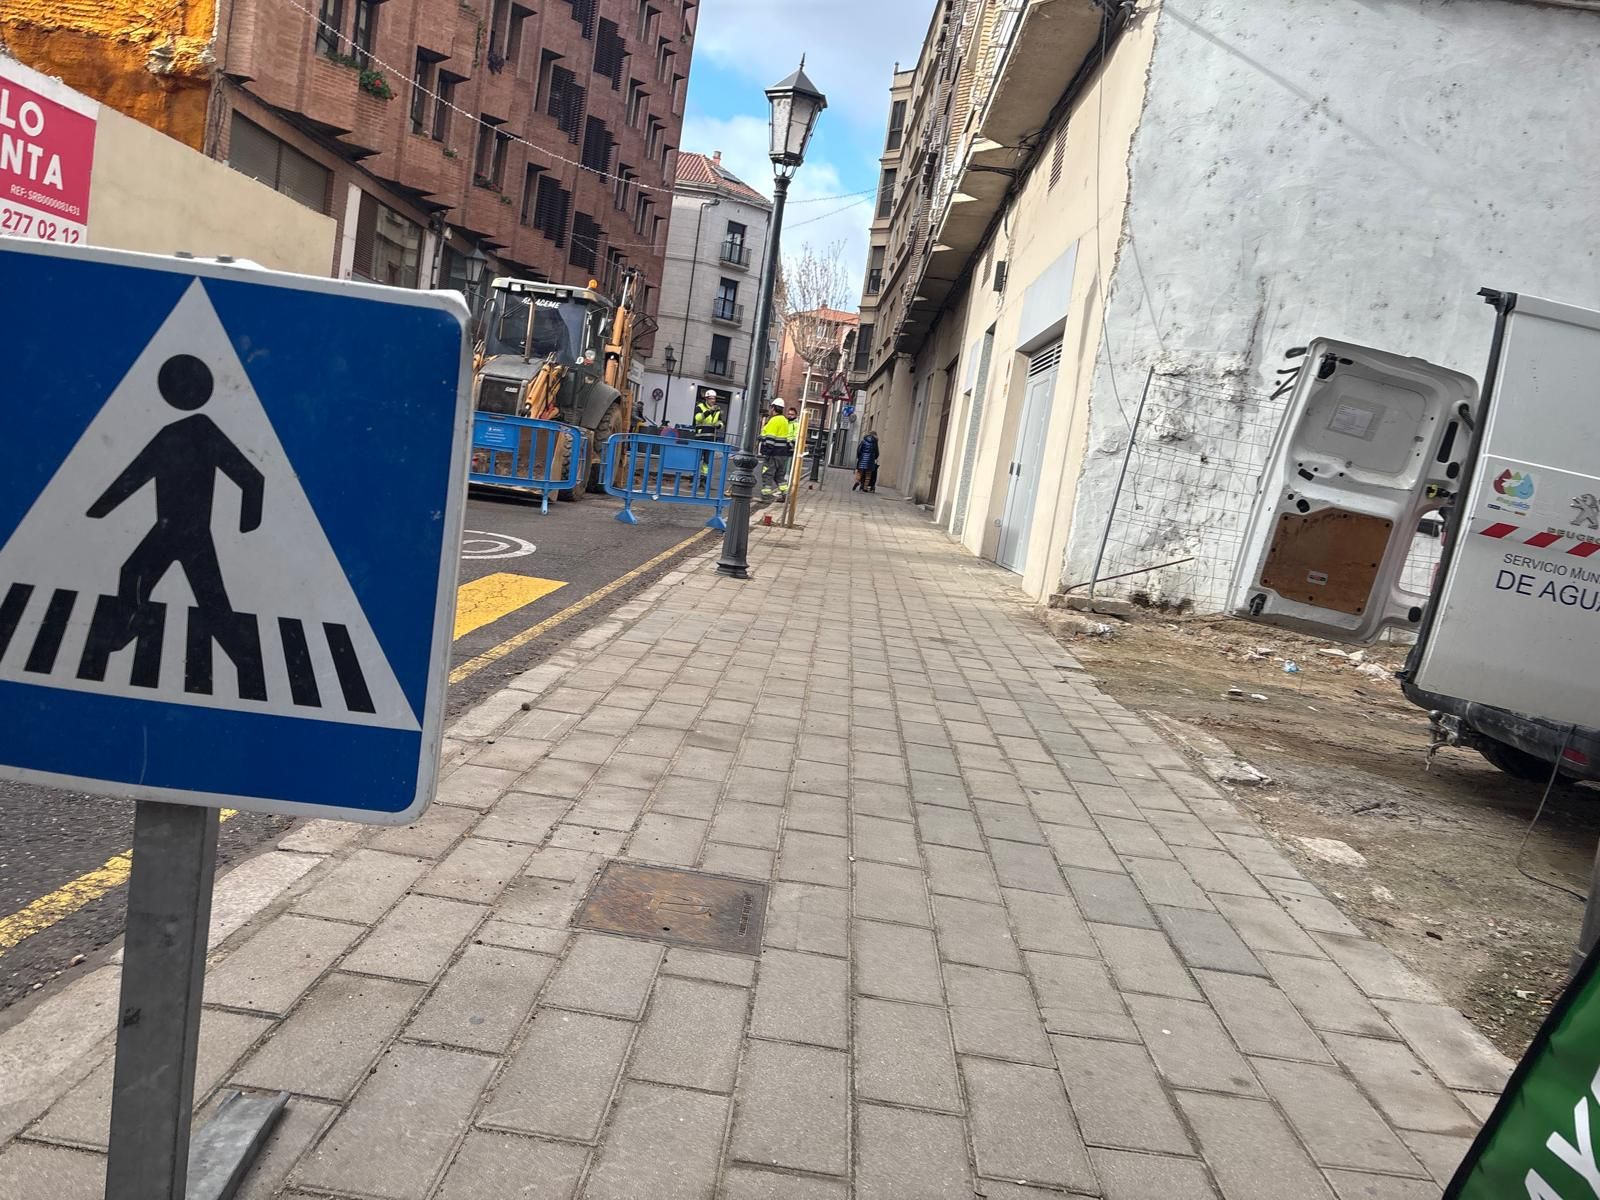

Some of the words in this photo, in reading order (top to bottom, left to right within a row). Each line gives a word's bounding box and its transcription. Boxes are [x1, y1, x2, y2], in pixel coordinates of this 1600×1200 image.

[0, 88, 44, 136] LO
[0, 133, 63, 190] NTA
[2, 208, 33, 234] 277
[37, 219, 56, 241] 02
[62, 227, 79, 244] 12
[1504, 553, 1568, 576] SERVICIO
[1496, 569, 1536, 596] DE
[1538, 580, 1600, 612] AGU
